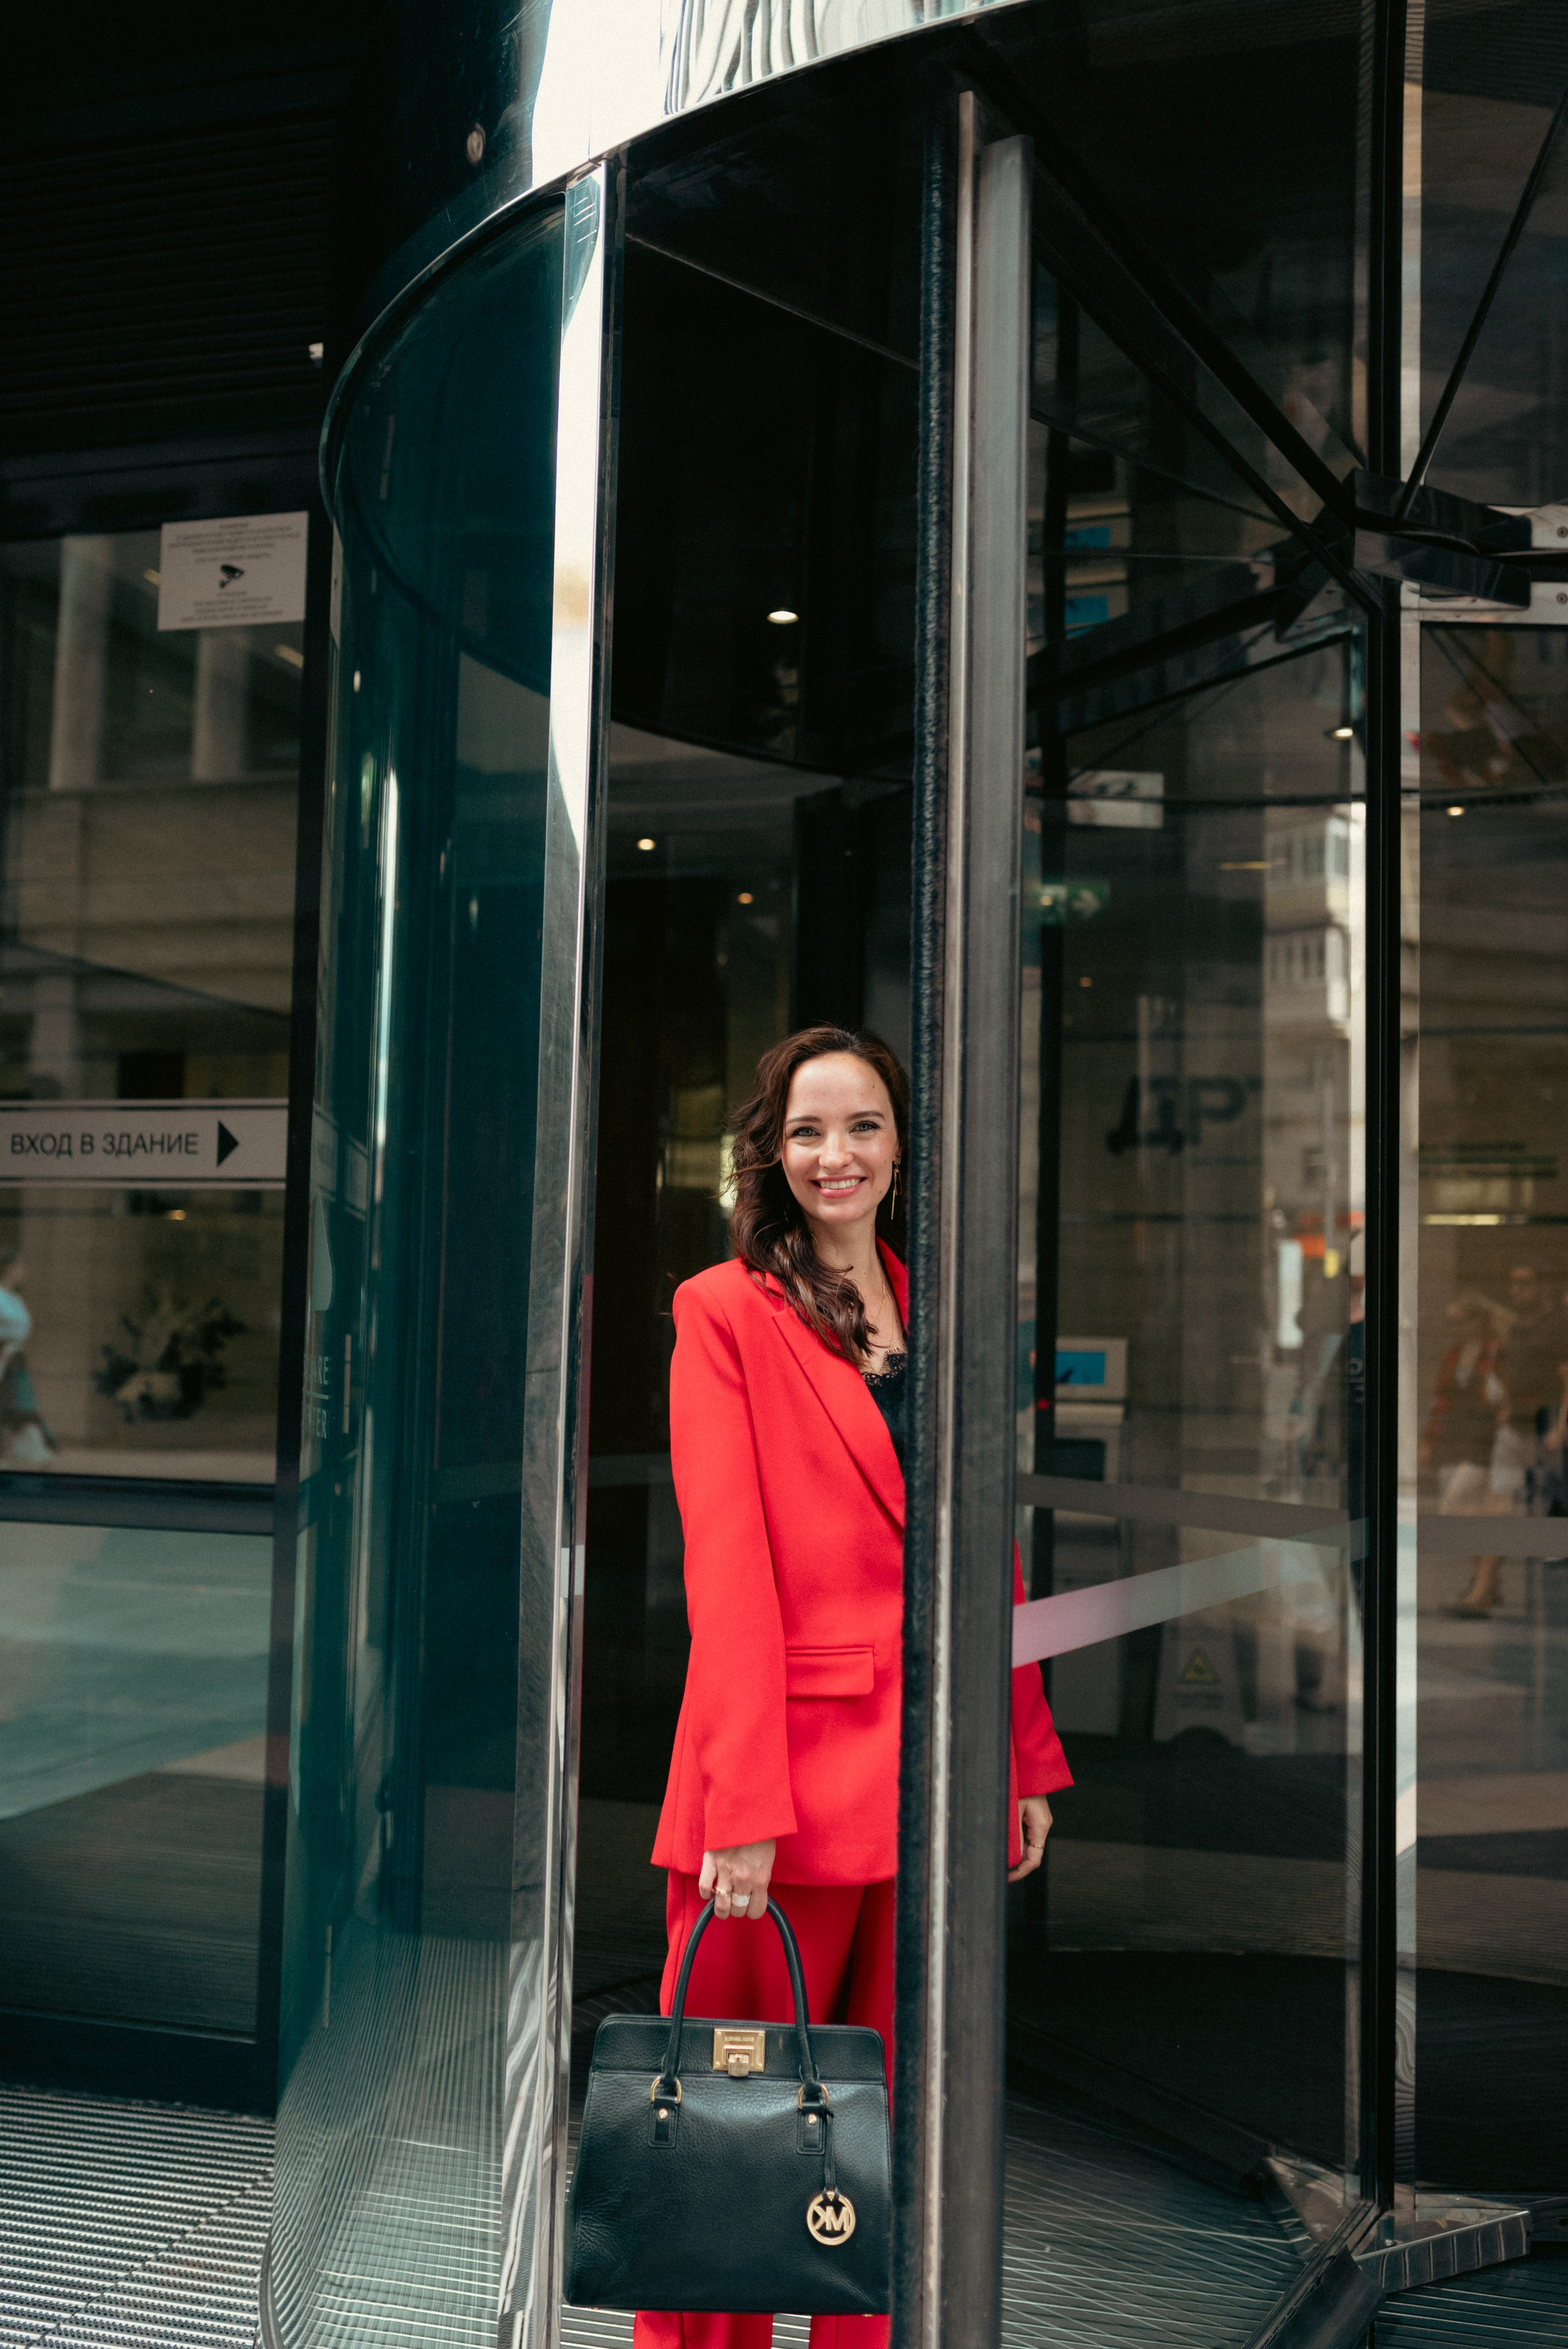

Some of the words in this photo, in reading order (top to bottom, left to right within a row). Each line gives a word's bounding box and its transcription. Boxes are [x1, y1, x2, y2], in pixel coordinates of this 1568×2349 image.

[11, 1133, 72, 1157] ВХОД
[80, 1134, 94, 1155] В
[102, 1133, 198, 1157] ЗДАНИЕ
